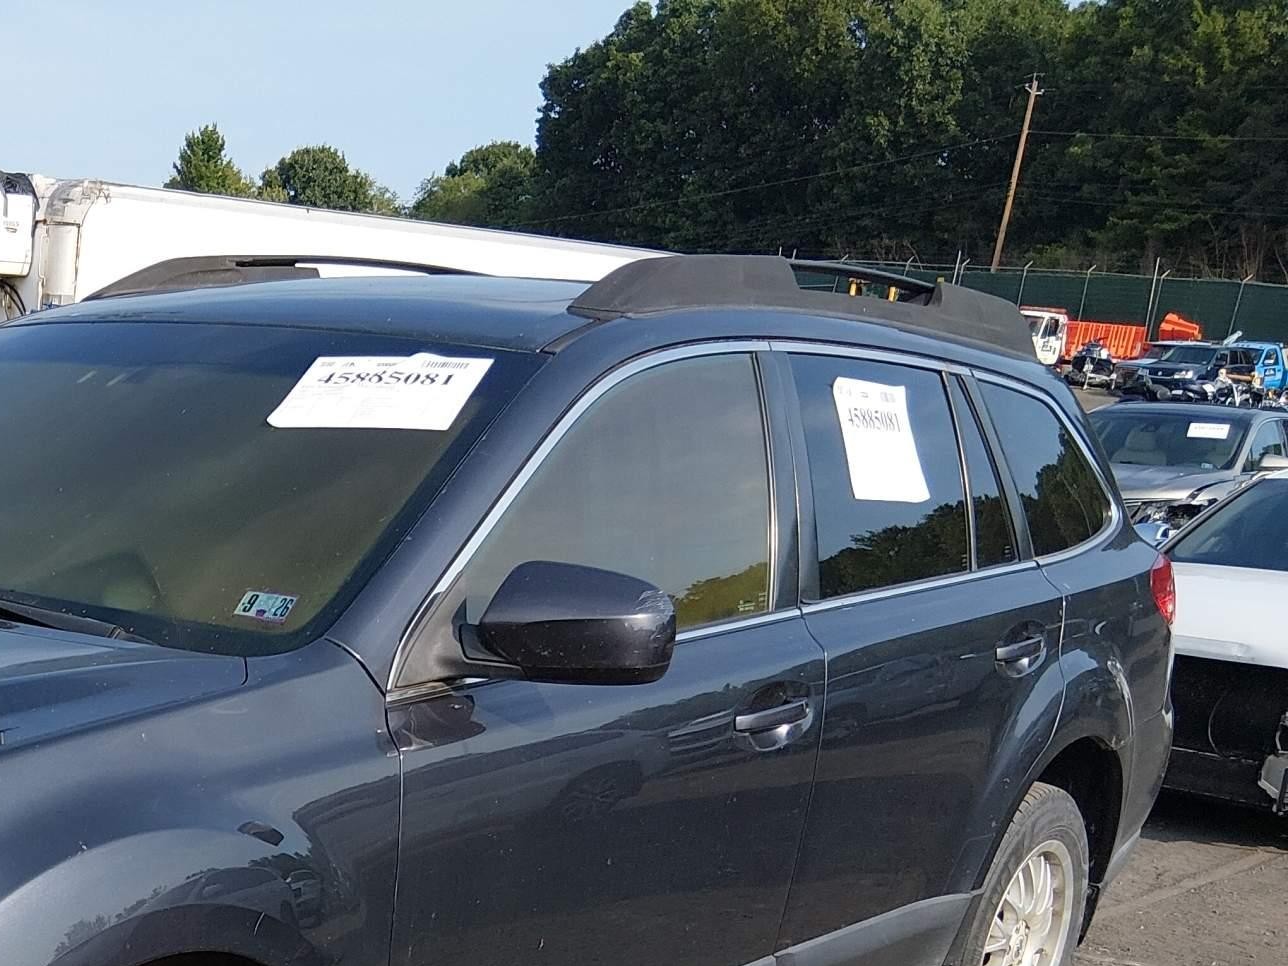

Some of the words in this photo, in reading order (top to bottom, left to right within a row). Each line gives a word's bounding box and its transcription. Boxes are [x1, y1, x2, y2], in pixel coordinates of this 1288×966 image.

[317, 370, 456, 387] 45885081
[848, 407, 901, 433] 45885081
[273, 597, 294, 617] 26
